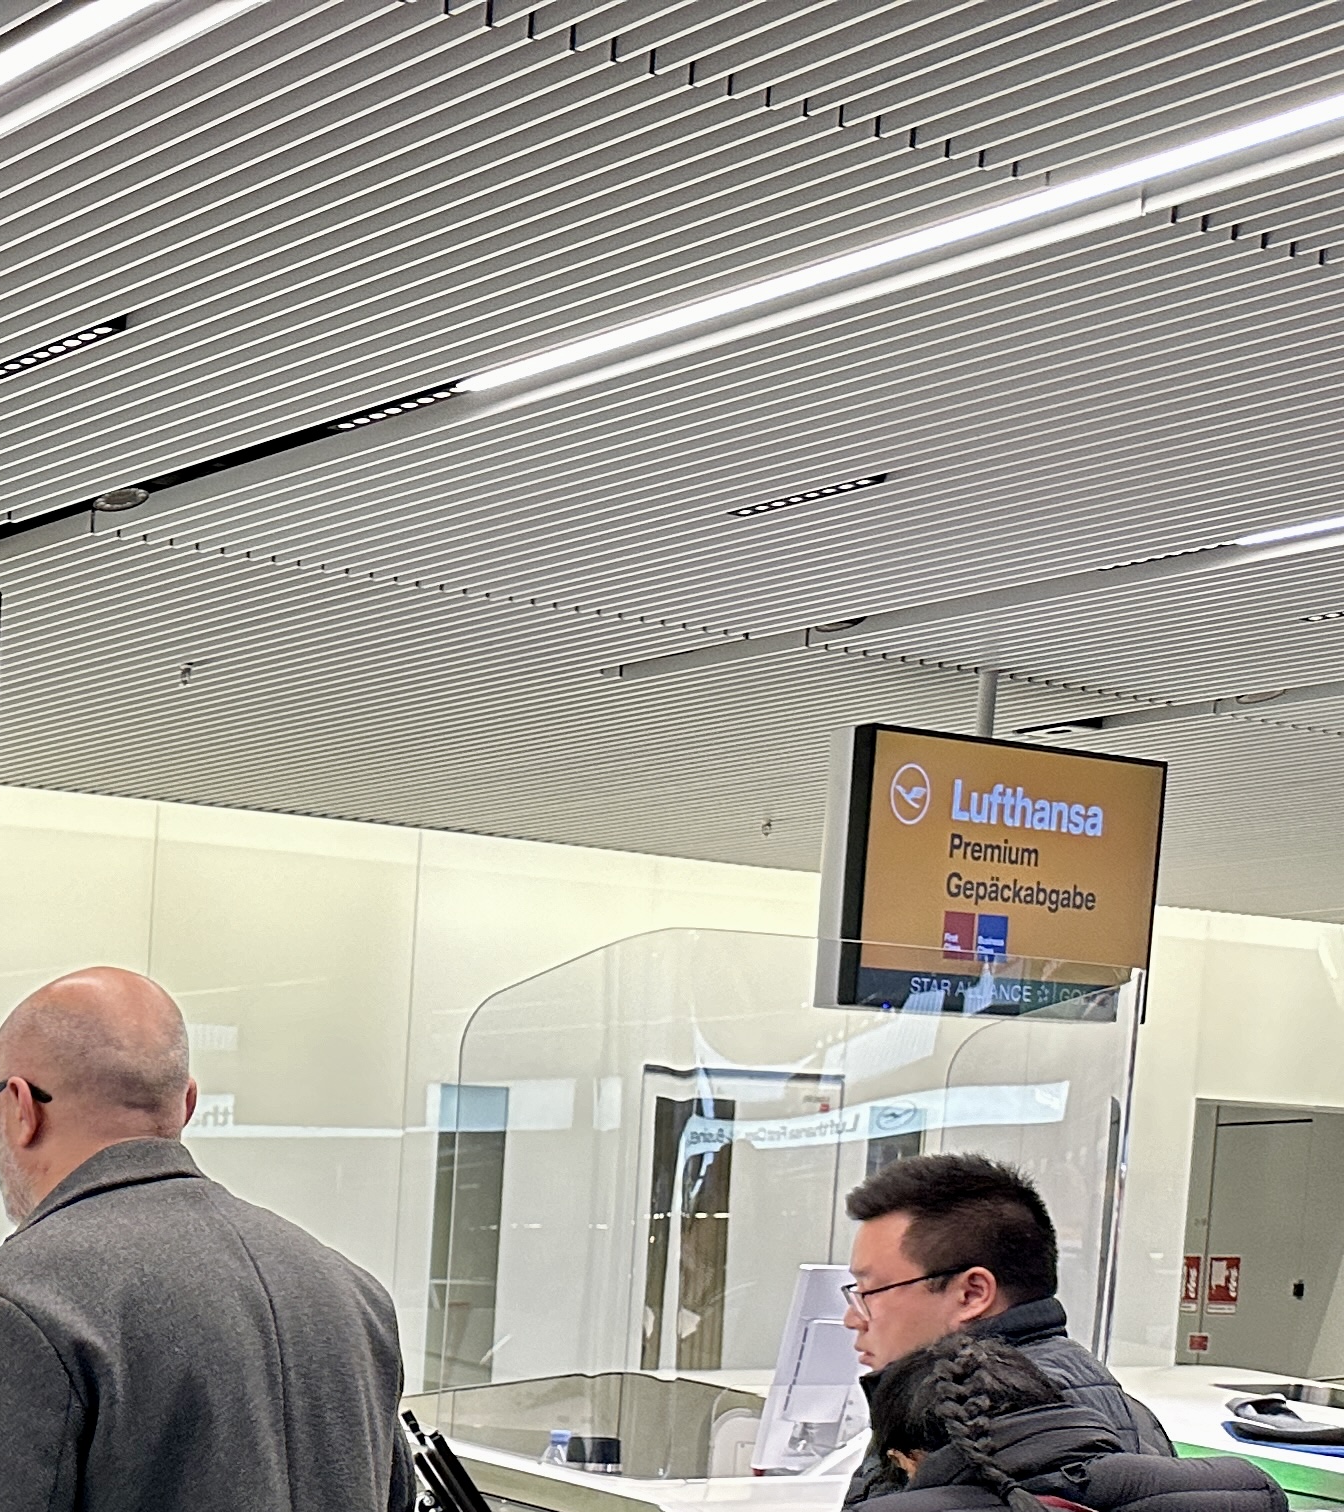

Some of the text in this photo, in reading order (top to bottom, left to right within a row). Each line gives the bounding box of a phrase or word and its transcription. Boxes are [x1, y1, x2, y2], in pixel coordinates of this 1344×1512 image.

[950, 778, 1104, 837] Lufthansa
[948, 833, 1040, 868] Premium
[945, 871, 1097, 914] Gepäckabgabe
[910, 976, 952, 996] STAR
[954, 980, 1033, 1003] ALANCE
